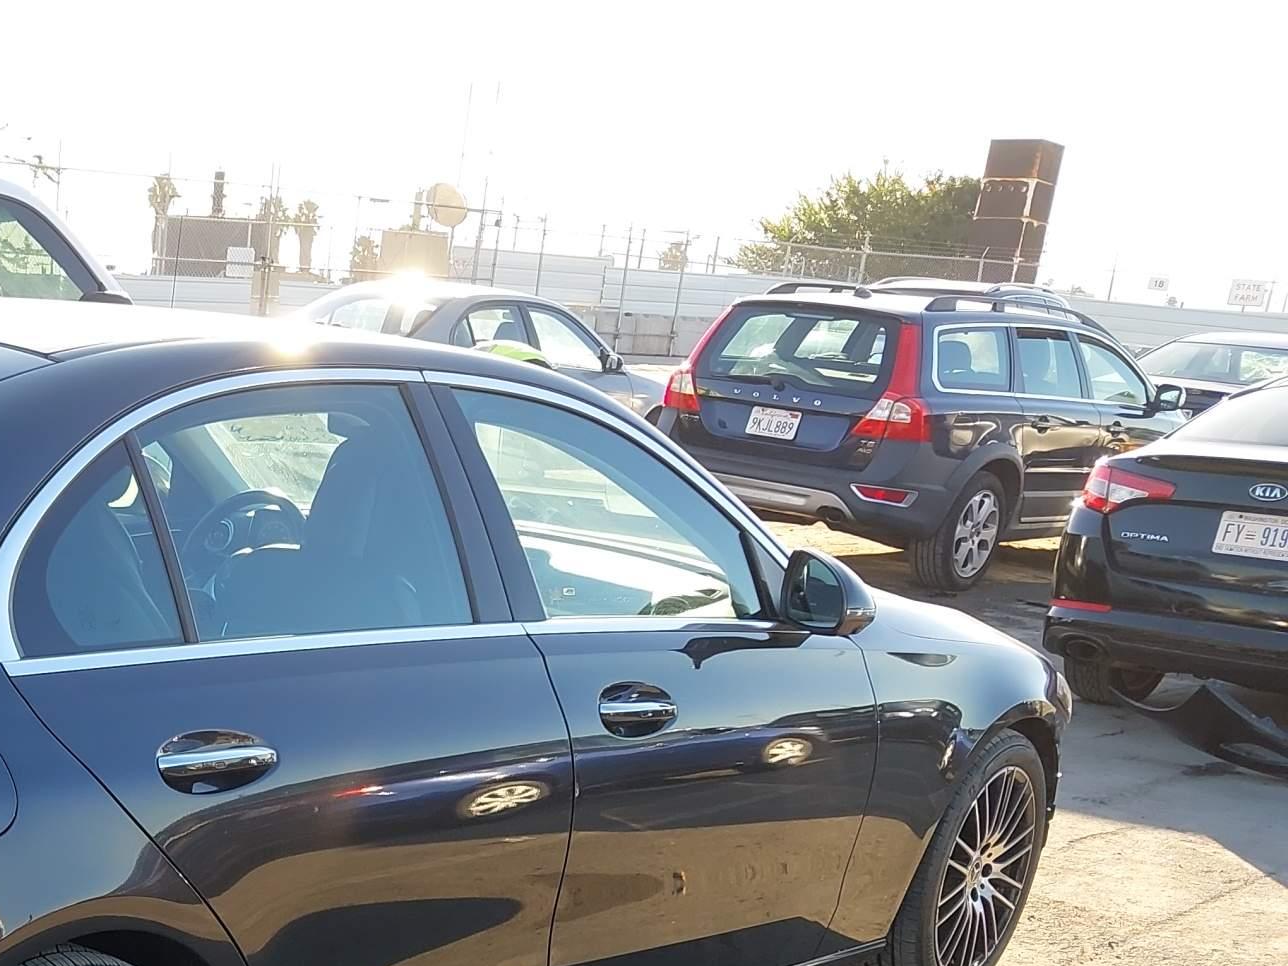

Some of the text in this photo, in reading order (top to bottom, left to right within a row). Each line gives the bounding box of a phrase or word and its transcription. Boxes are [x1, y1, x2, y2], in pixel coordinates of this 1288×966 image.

[1236, 283, 1263, 292] STATE
[1234, 294, 1259, 303] FARM
[733, 388, 822, 407] VOLVO
[749, 416, 795, 436] 9KJL889
[1255, 486, 1281, 498] KIA
[1120, 531, 1169, 542] OPTIMA
